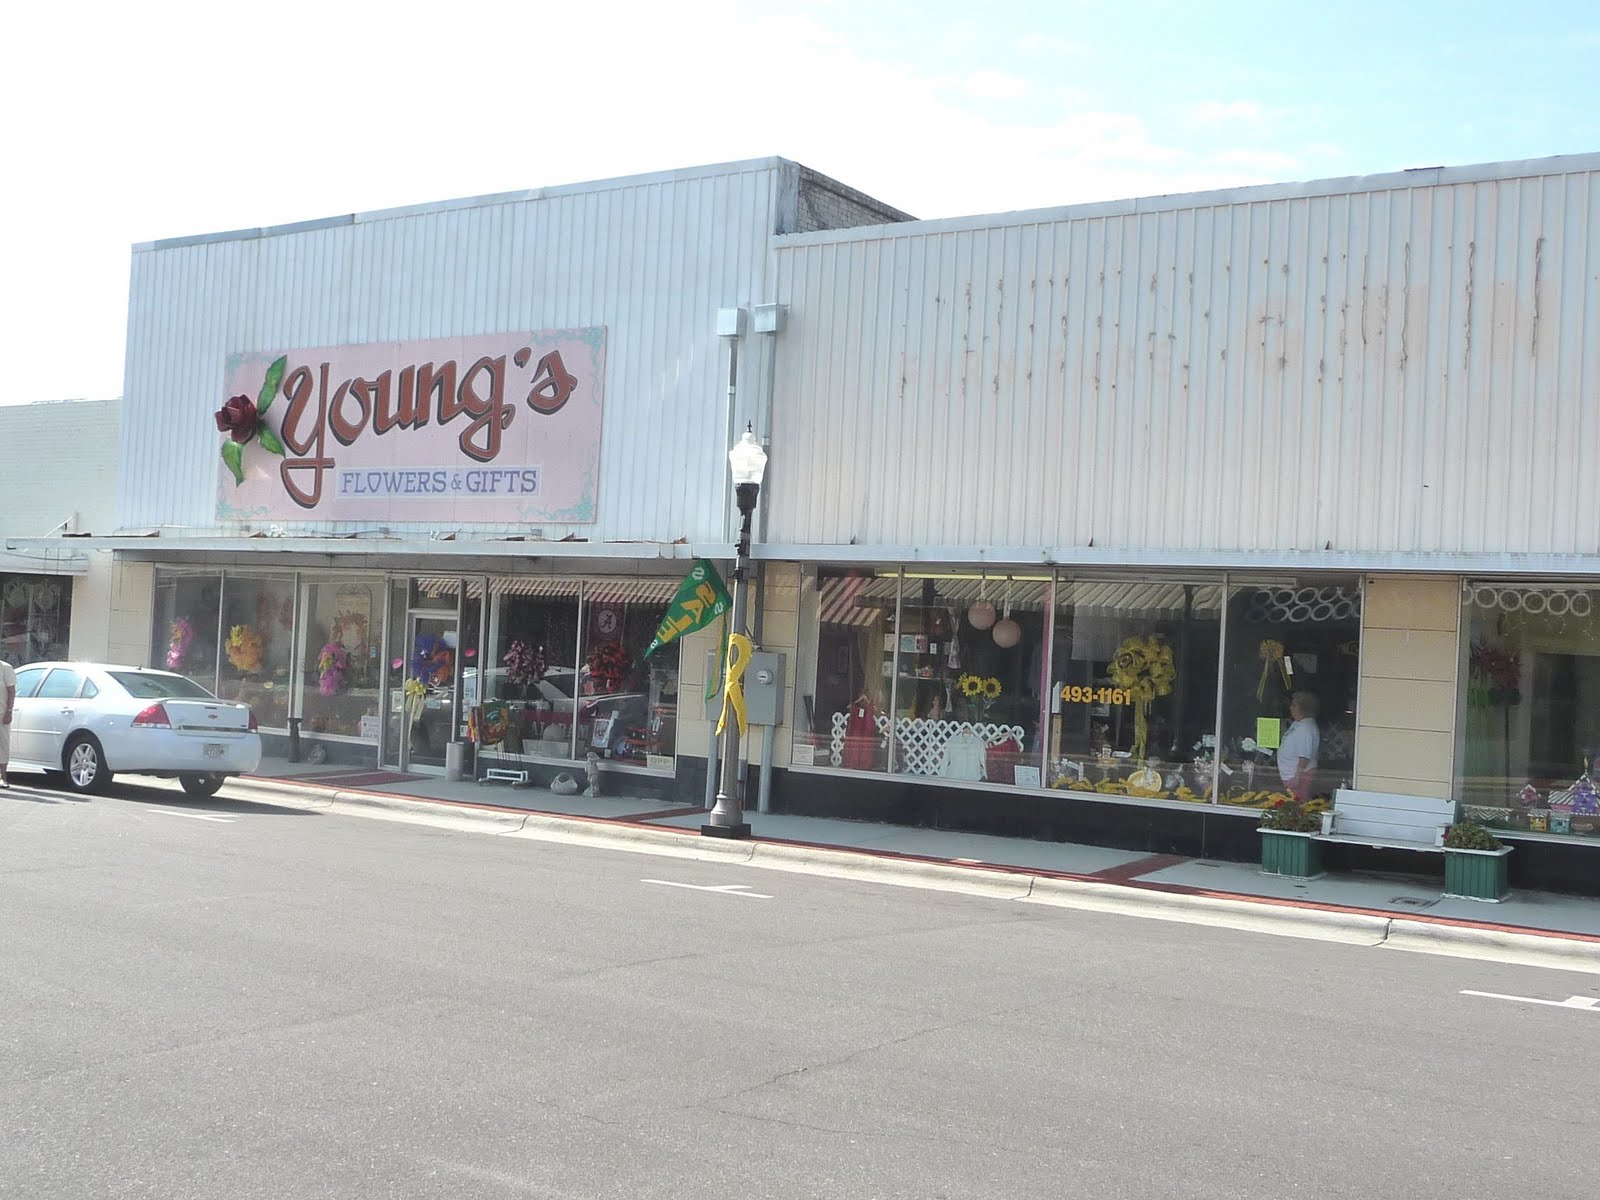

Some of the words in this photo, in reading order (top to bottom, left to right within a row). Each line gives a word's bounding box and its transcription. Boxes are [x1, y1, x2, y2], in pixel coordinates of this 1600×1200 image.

[280, 346, 578, 509] Young's
[341, 470, 447, 493] FLOWERS
[450, 473, 463, 490] &
[465, 470, 537, 493] GIFTS
[1060, 685, 1132, 706] 493-1161
